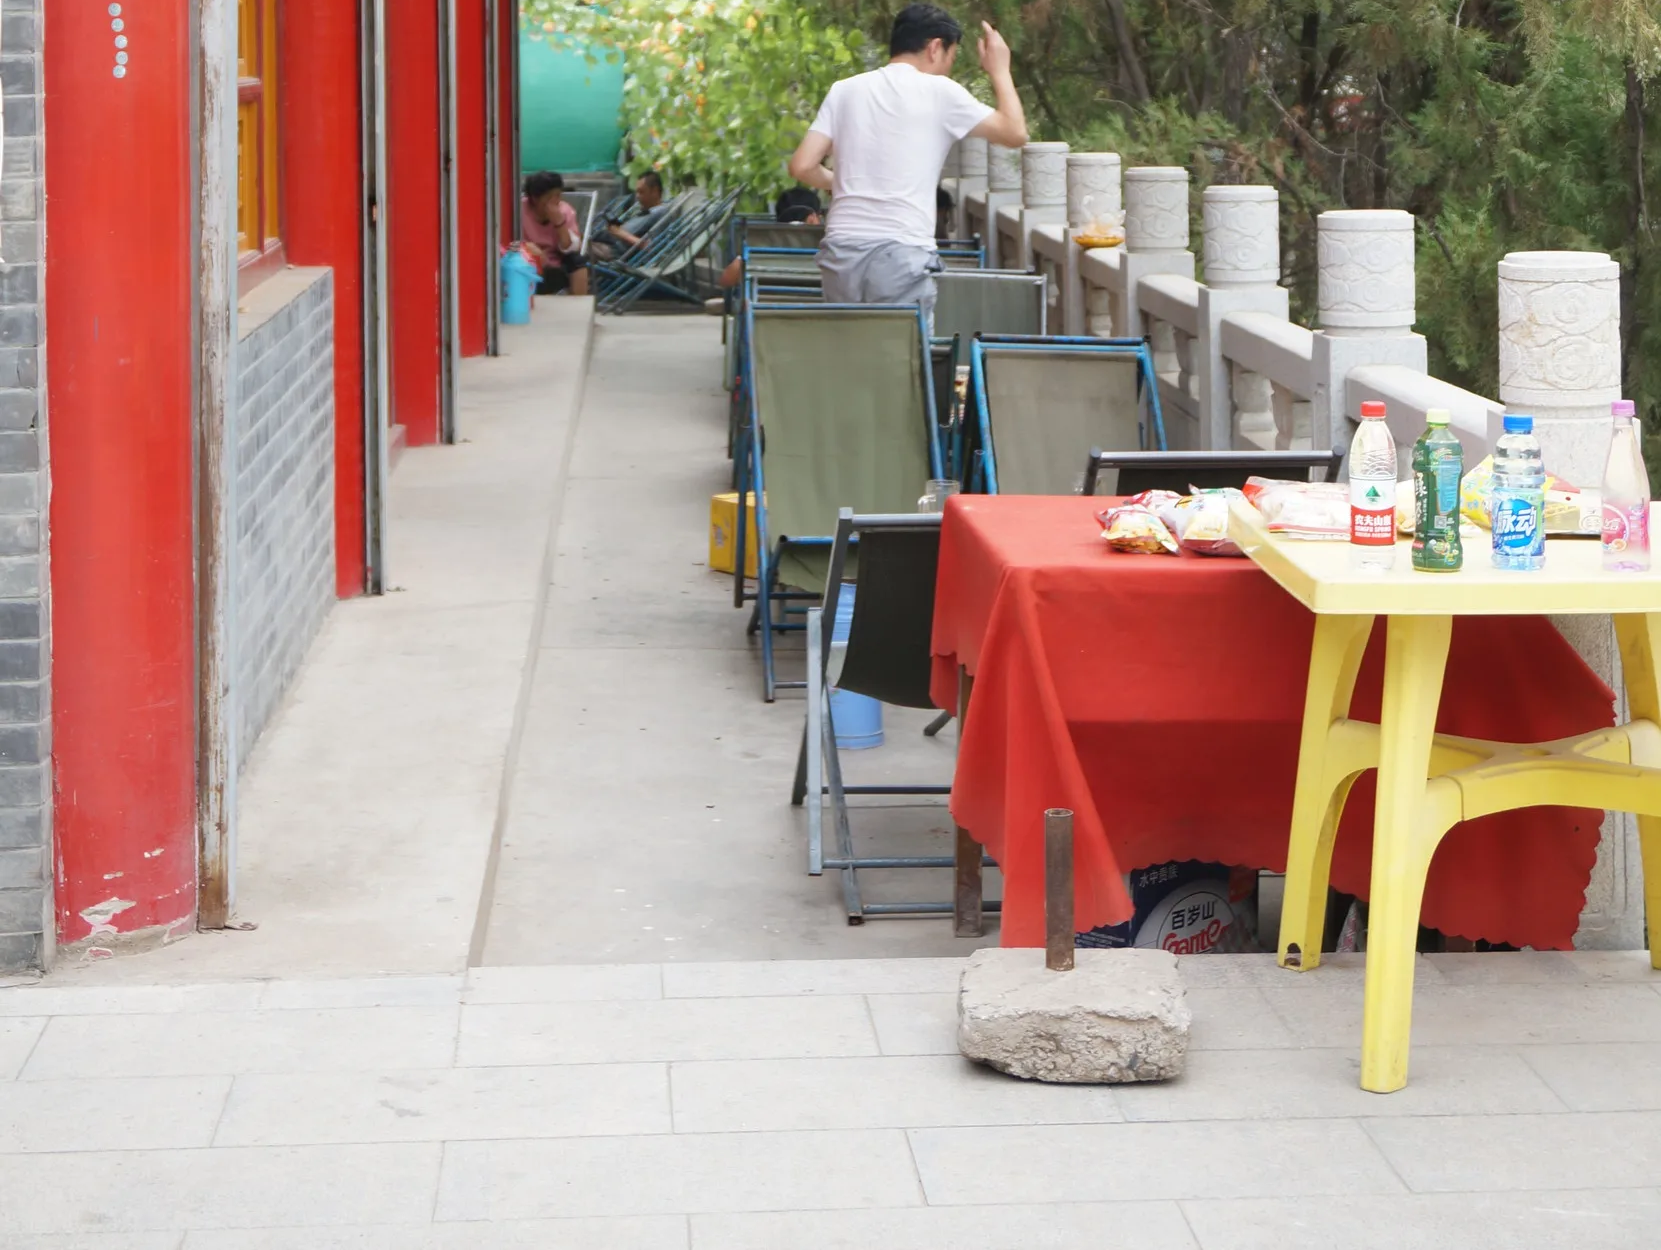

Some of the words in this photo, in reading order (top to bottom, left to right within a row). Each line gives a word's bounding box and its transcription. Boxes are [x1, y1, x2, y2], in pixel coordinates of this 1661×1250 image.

[1495, 506, 1538, 537] 脉动
[1139, 864, 1179, 888] 水中贵族
[1171, 901, 1216, 931] 百岁山
[1162, 918, 1231, 954] Gante
